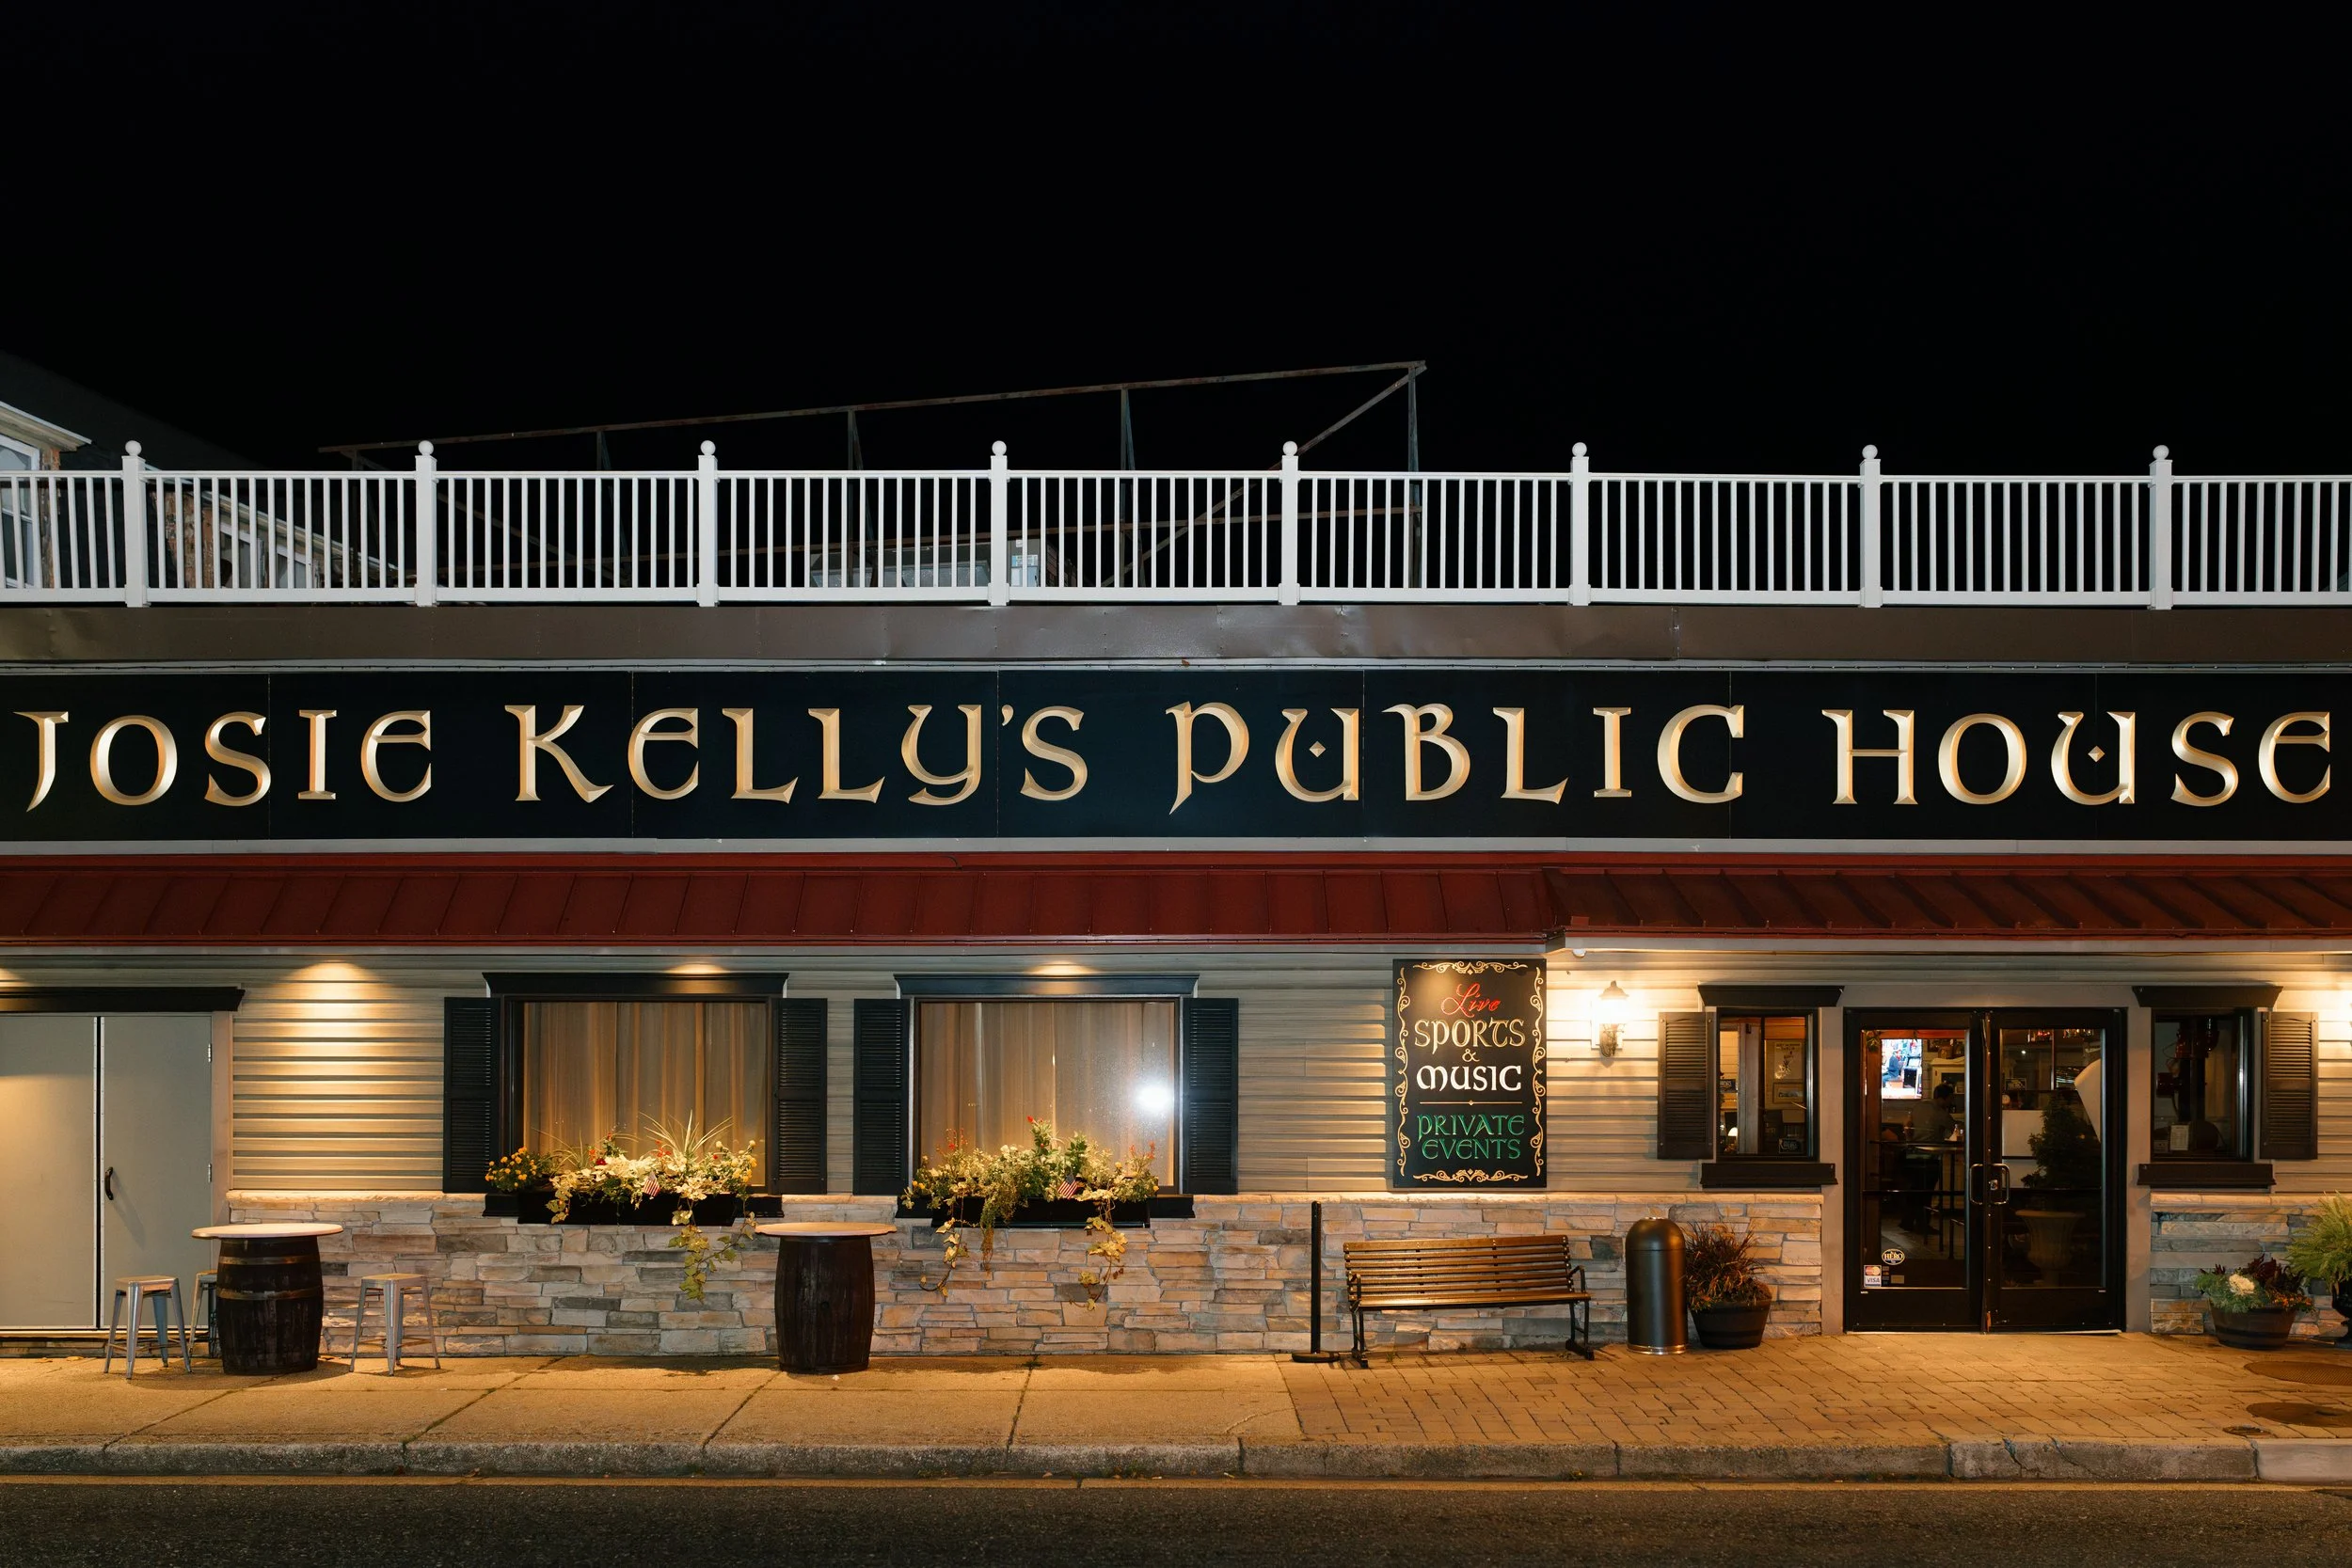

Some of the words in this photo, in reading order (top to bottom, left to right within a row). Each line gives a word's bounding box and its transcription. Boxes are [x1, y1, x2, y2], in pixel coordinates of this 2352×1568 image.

[13, 710, 432, 812] JOSIE
[504, 704, 1089, 807] KELLY'S
[1165, 701, 1745, 816] PUBLIC
[1821, 709, 2331, 807] HOUSE
[1440, 982, 1502, 1018] Live
[1414, 1017, 1526, 1054] SPORTS
[1461, 1048, 1481, 1063] &
[1416, 1065, 1522, 1092] MUSIC
[1417, 1114, 1525, 1141] PRIVATE
[1421, 1138, 1521, 1160] EVENTS
